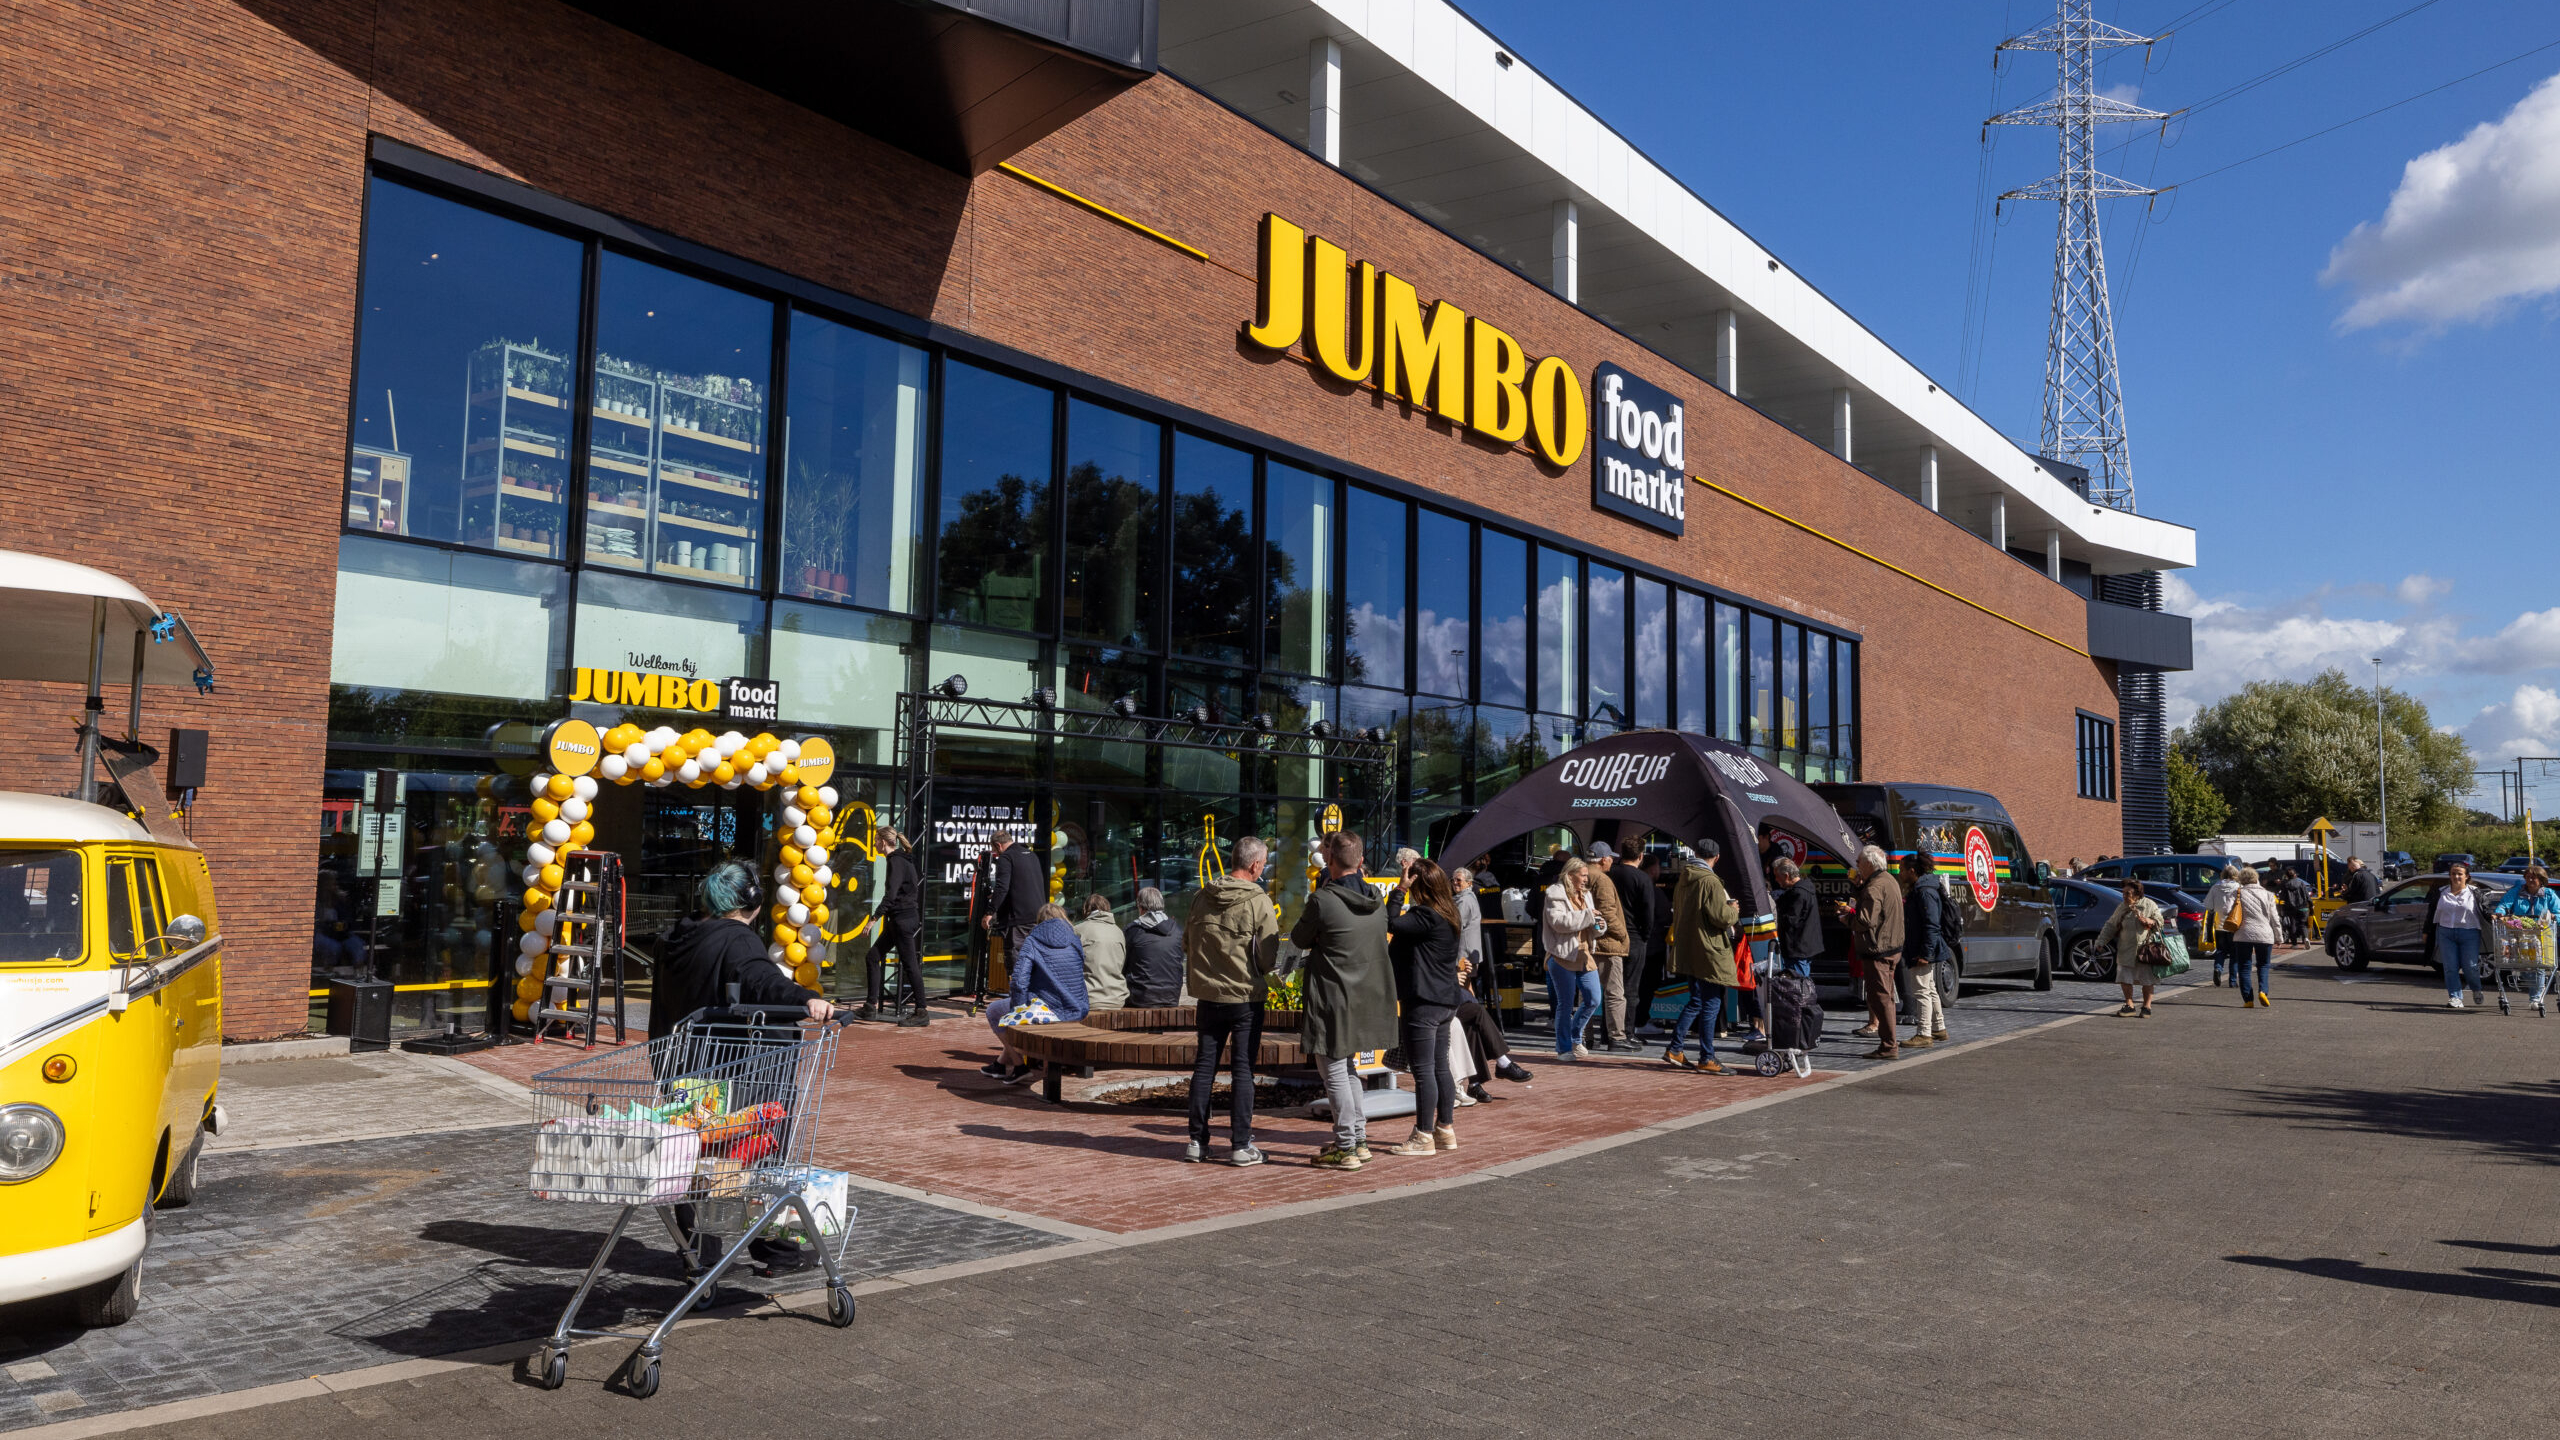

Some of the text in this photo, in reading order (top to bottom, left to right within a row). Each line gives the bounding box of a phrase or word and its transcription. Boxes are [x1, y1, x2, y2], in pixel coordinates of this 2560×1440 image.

[1242, 212, 1587, 467] JUMBO
[1602, 374, 1685, 471] food
[1603, 456, 1685, 521] markt
[628, 652, 698, 677] Welkom bij
[569, 667, 720, 712] JUMBO
[730, 680, 777, 704] food
[730, 704, 776, 720] markt
[555, 740, 595, 755] JUMBO
[799, 757, 830, 768] JUMBO
[1560, 753, 1672, 793] COUREUR
[952, 805, 1023, 819] BIJ ONS VIND JE
[1571, 798, 1638, 808] ESPRESSO
